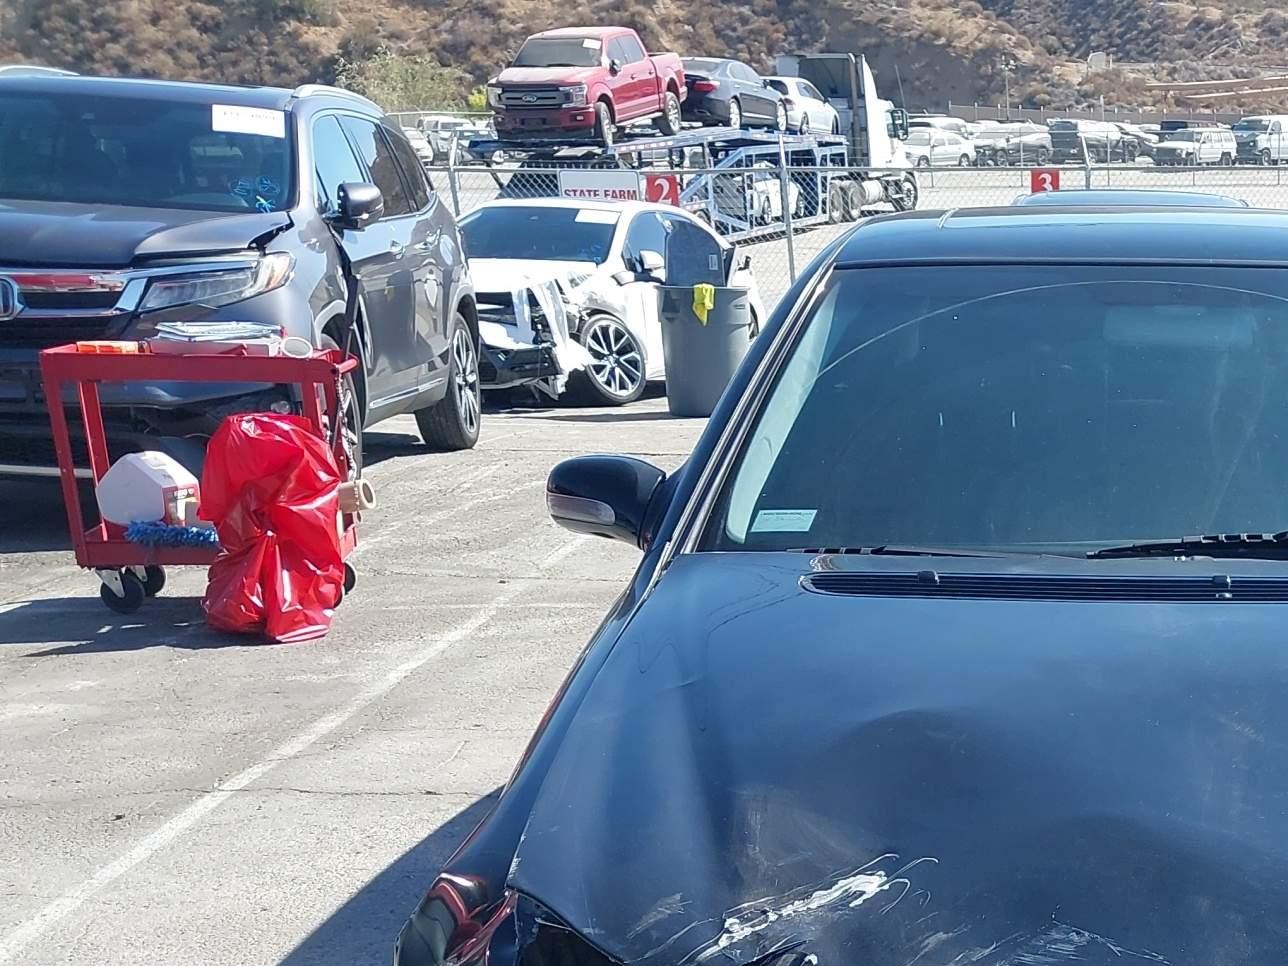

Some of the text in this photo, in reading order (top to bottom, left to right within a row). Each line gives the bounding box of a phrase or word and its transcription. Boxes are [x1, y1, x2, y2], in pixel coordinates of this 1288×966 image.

[654, 178, 674, 202] 2
[1038, 173, 1054, 191] 3
[564, 188, 638, 200] STATE FARM
